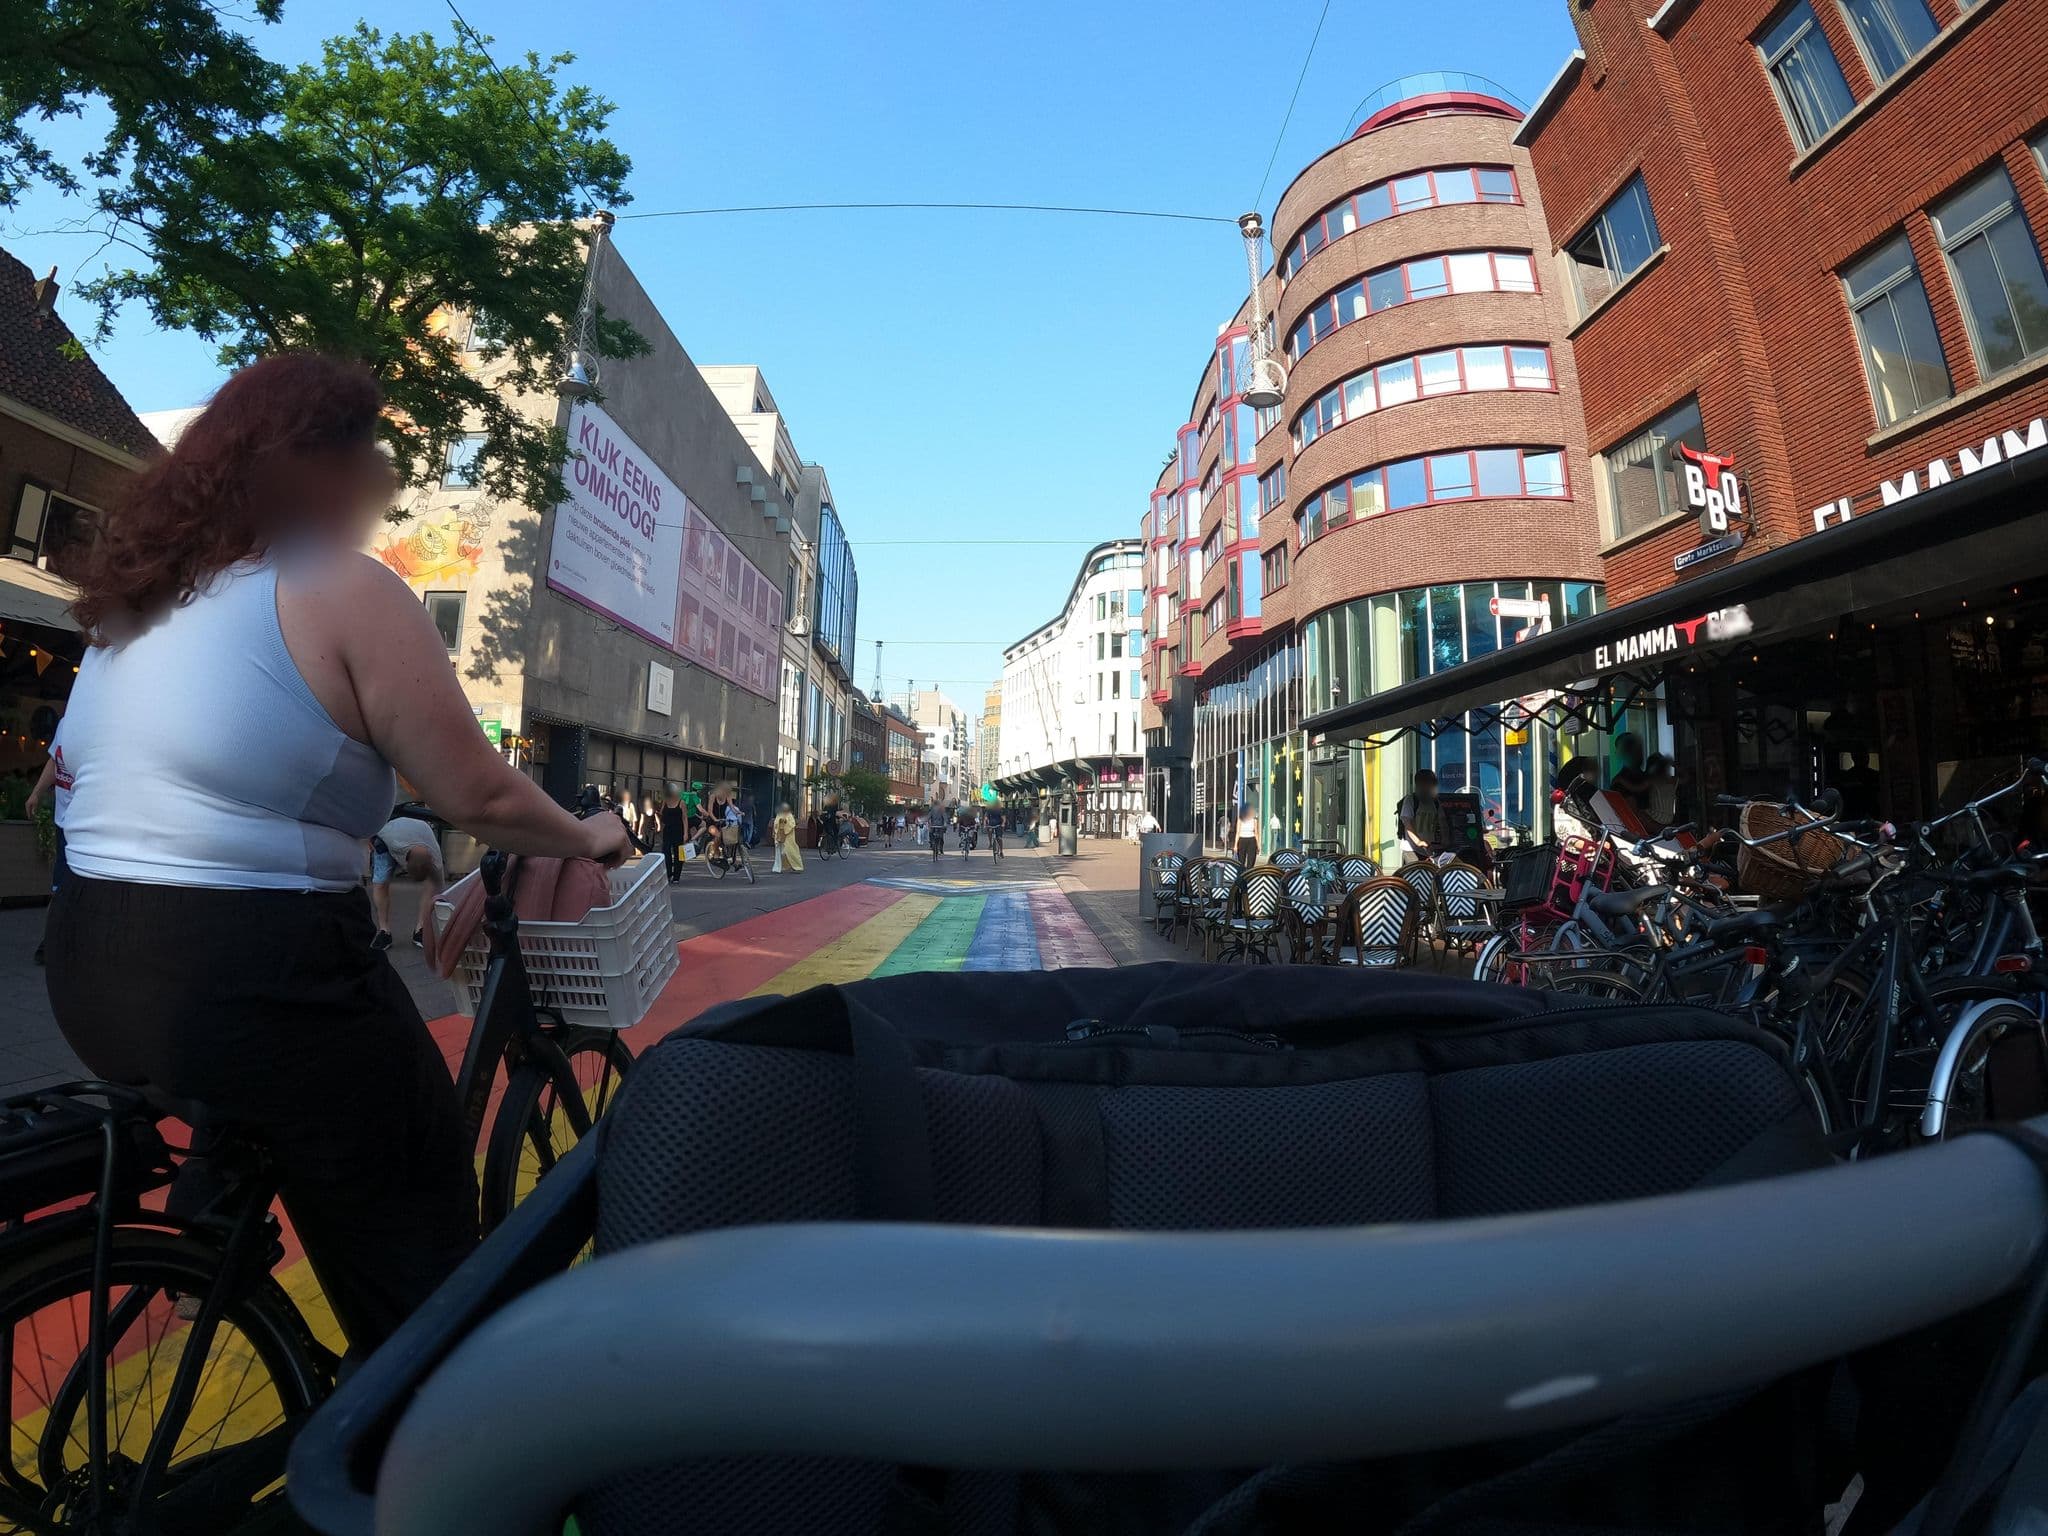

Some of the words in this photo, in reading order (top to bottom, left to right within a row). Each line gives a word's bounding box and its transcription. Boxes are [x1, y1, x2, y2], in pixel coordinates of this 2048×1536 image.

[574, 454, 656, 542] OMHOOG!
[579, 414, 621, 476] KIJK
[622, 456, 661, 512] EENS
[1685, 464, 1742, 530] BBQ
[1595, 644, 1612, 670] EL
[1615, 624, 1678, 664] MAMMA
